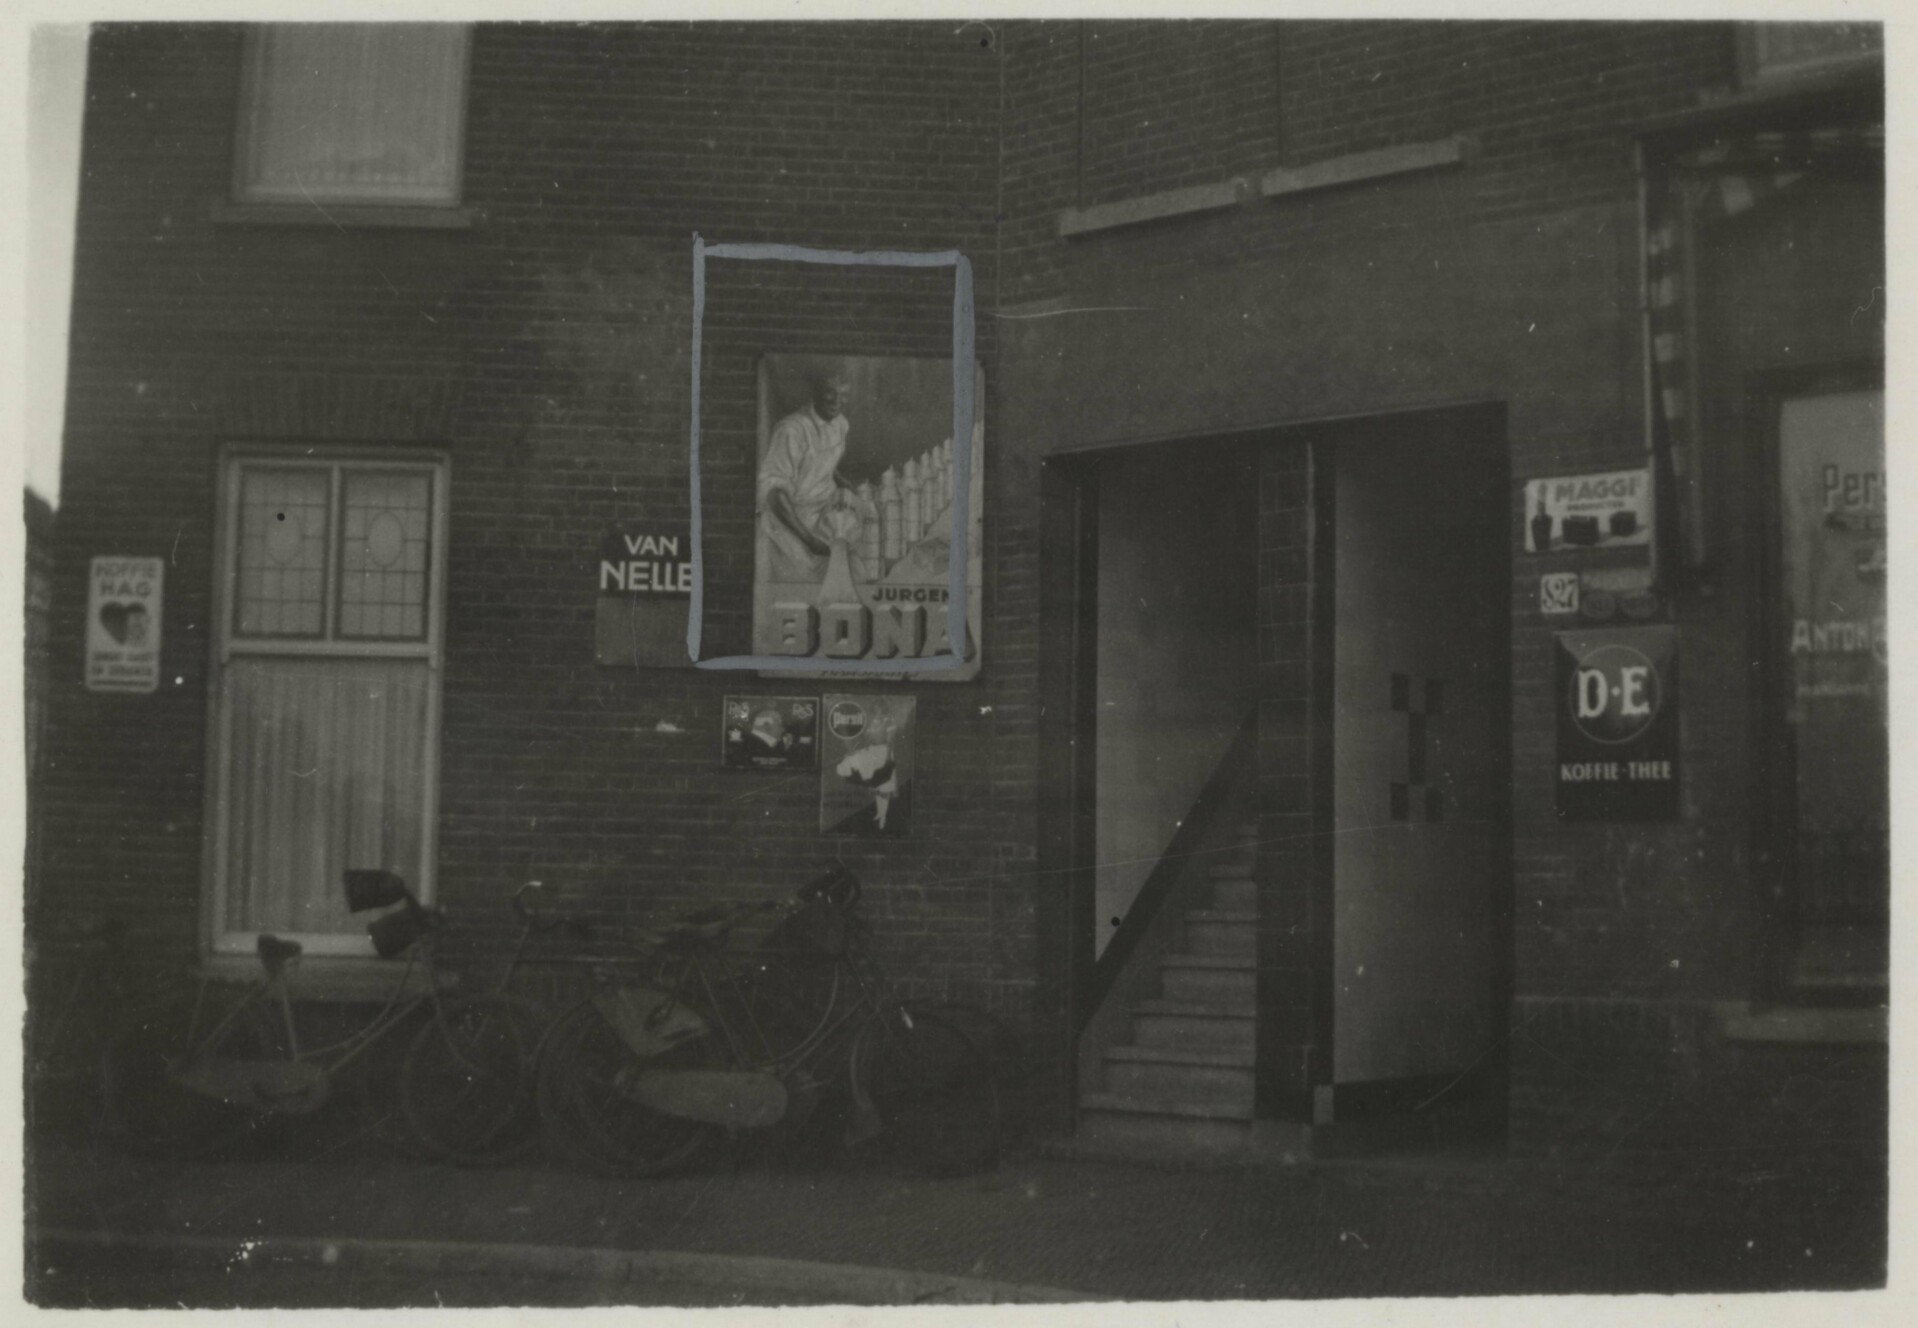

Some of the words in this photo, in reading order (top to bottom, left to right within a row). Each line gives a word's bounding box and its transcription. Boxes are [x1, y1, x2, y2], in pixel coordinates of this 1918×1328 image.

[1556, 477, 1636, 502] MAGGI
[623, 534, 679, 556] VAN
[600, 560, 692, 592] NELLE
[100, 580, 152, 599] HAG
[766, 602, 976, 662] BONA
